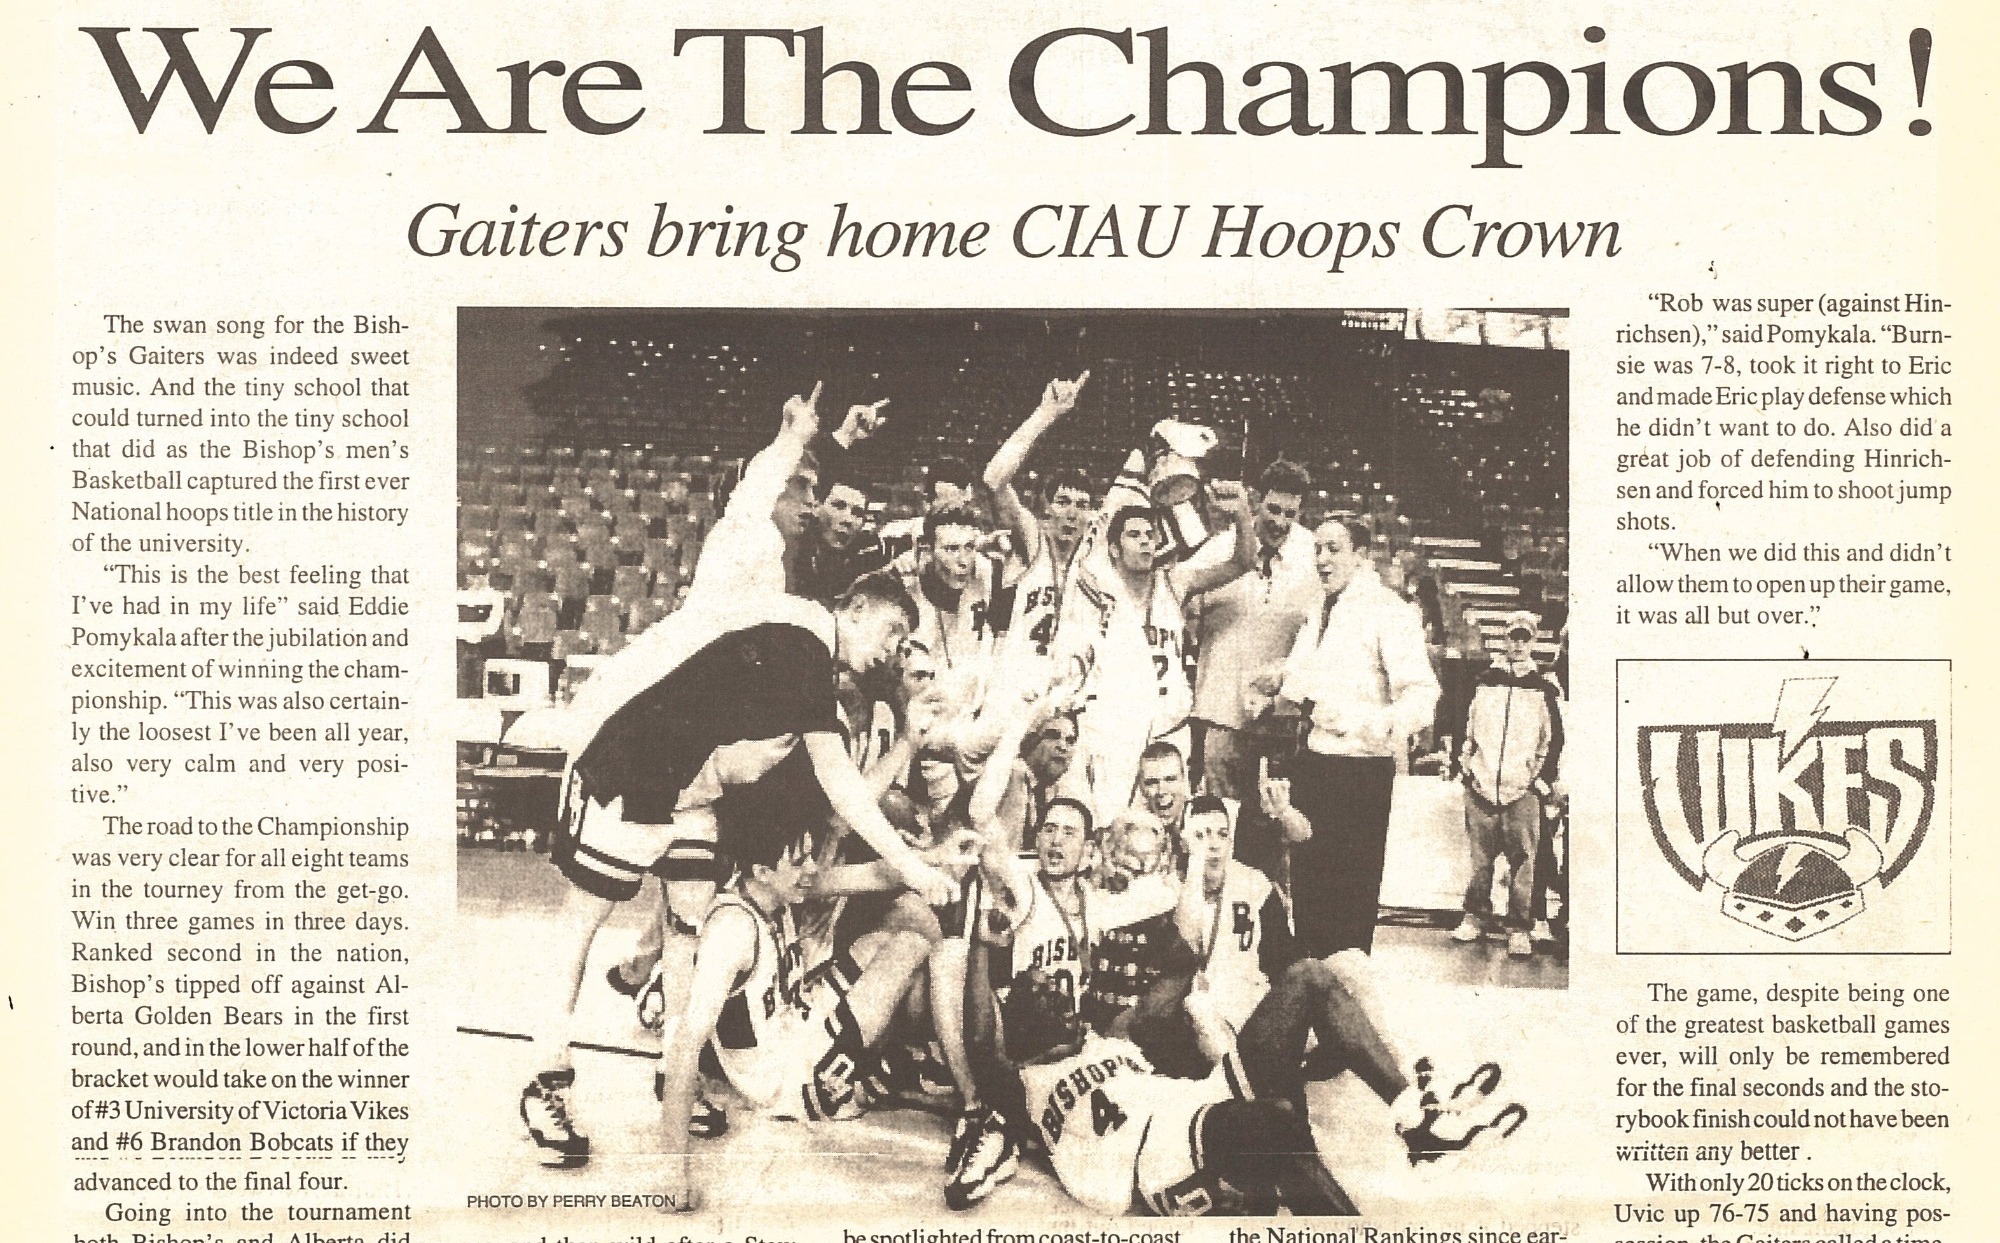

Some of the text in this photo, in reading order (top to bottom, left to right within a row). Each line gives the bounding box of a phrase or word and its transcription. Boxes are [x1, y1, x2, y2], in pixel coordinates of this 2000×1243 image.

[78, 26, 336, 135] We
[357, 26, 646, 136] Are
[674, 26, 975, 136] The
[408, 202, 1622, 273] Gaiters bring home CIAU Hoops Crown
[1649, 293, 1951, 317] "Rob was super (against Hin-
[104, 315, 408, 339] The swan song for the Bish-
[1617, 355, 1951, 379] sie was 7-8, took it right to Eric
[73, 377, 409, 401] music. And the tiny school that
[73, 439, 408, 463] that did as the Bishop's men's
[1617, 449, 1951, 472] great job of defending Hinrich-
[1649, 543, 1951, 561] "When we did this and didn't
[104, 565, 409, 589] "This is the best feeling that
[1617, 605, 1820, 624] it was all but over."
[72, 627, 408, 651] Pomykala after the jubilation and
[72, 690, 408, 714] pionship. "This was also certain-
[103, 816, 408, 841] The road to the Championship
[72, 879, 408, 904] in the tourney from the get-go.
[72, 943, 408, 964] Ranked second in the nation,
[72, 1006, 409, 1025] berta Golden Bears in the first
[1617, 1015, 1949, 1038] of the greatest basketball games
[72, 1069, 409, 1088] bracket would take on the winner
[1617, 1077, 1948, 1096] for the final seconds and the sto-
[1090, 1088, 1128, 1137] 4
[72, 1132, 408, 1158] and #6 Brandon Bobcats if they
[468, 1195, 676, 1208] PHOTO BY PERRY BEATON
[106, 1203, 411, 1226] Going into the tournament
[1614, 1203, 1950, 1227] Uvic up 76-75 and having pos-
